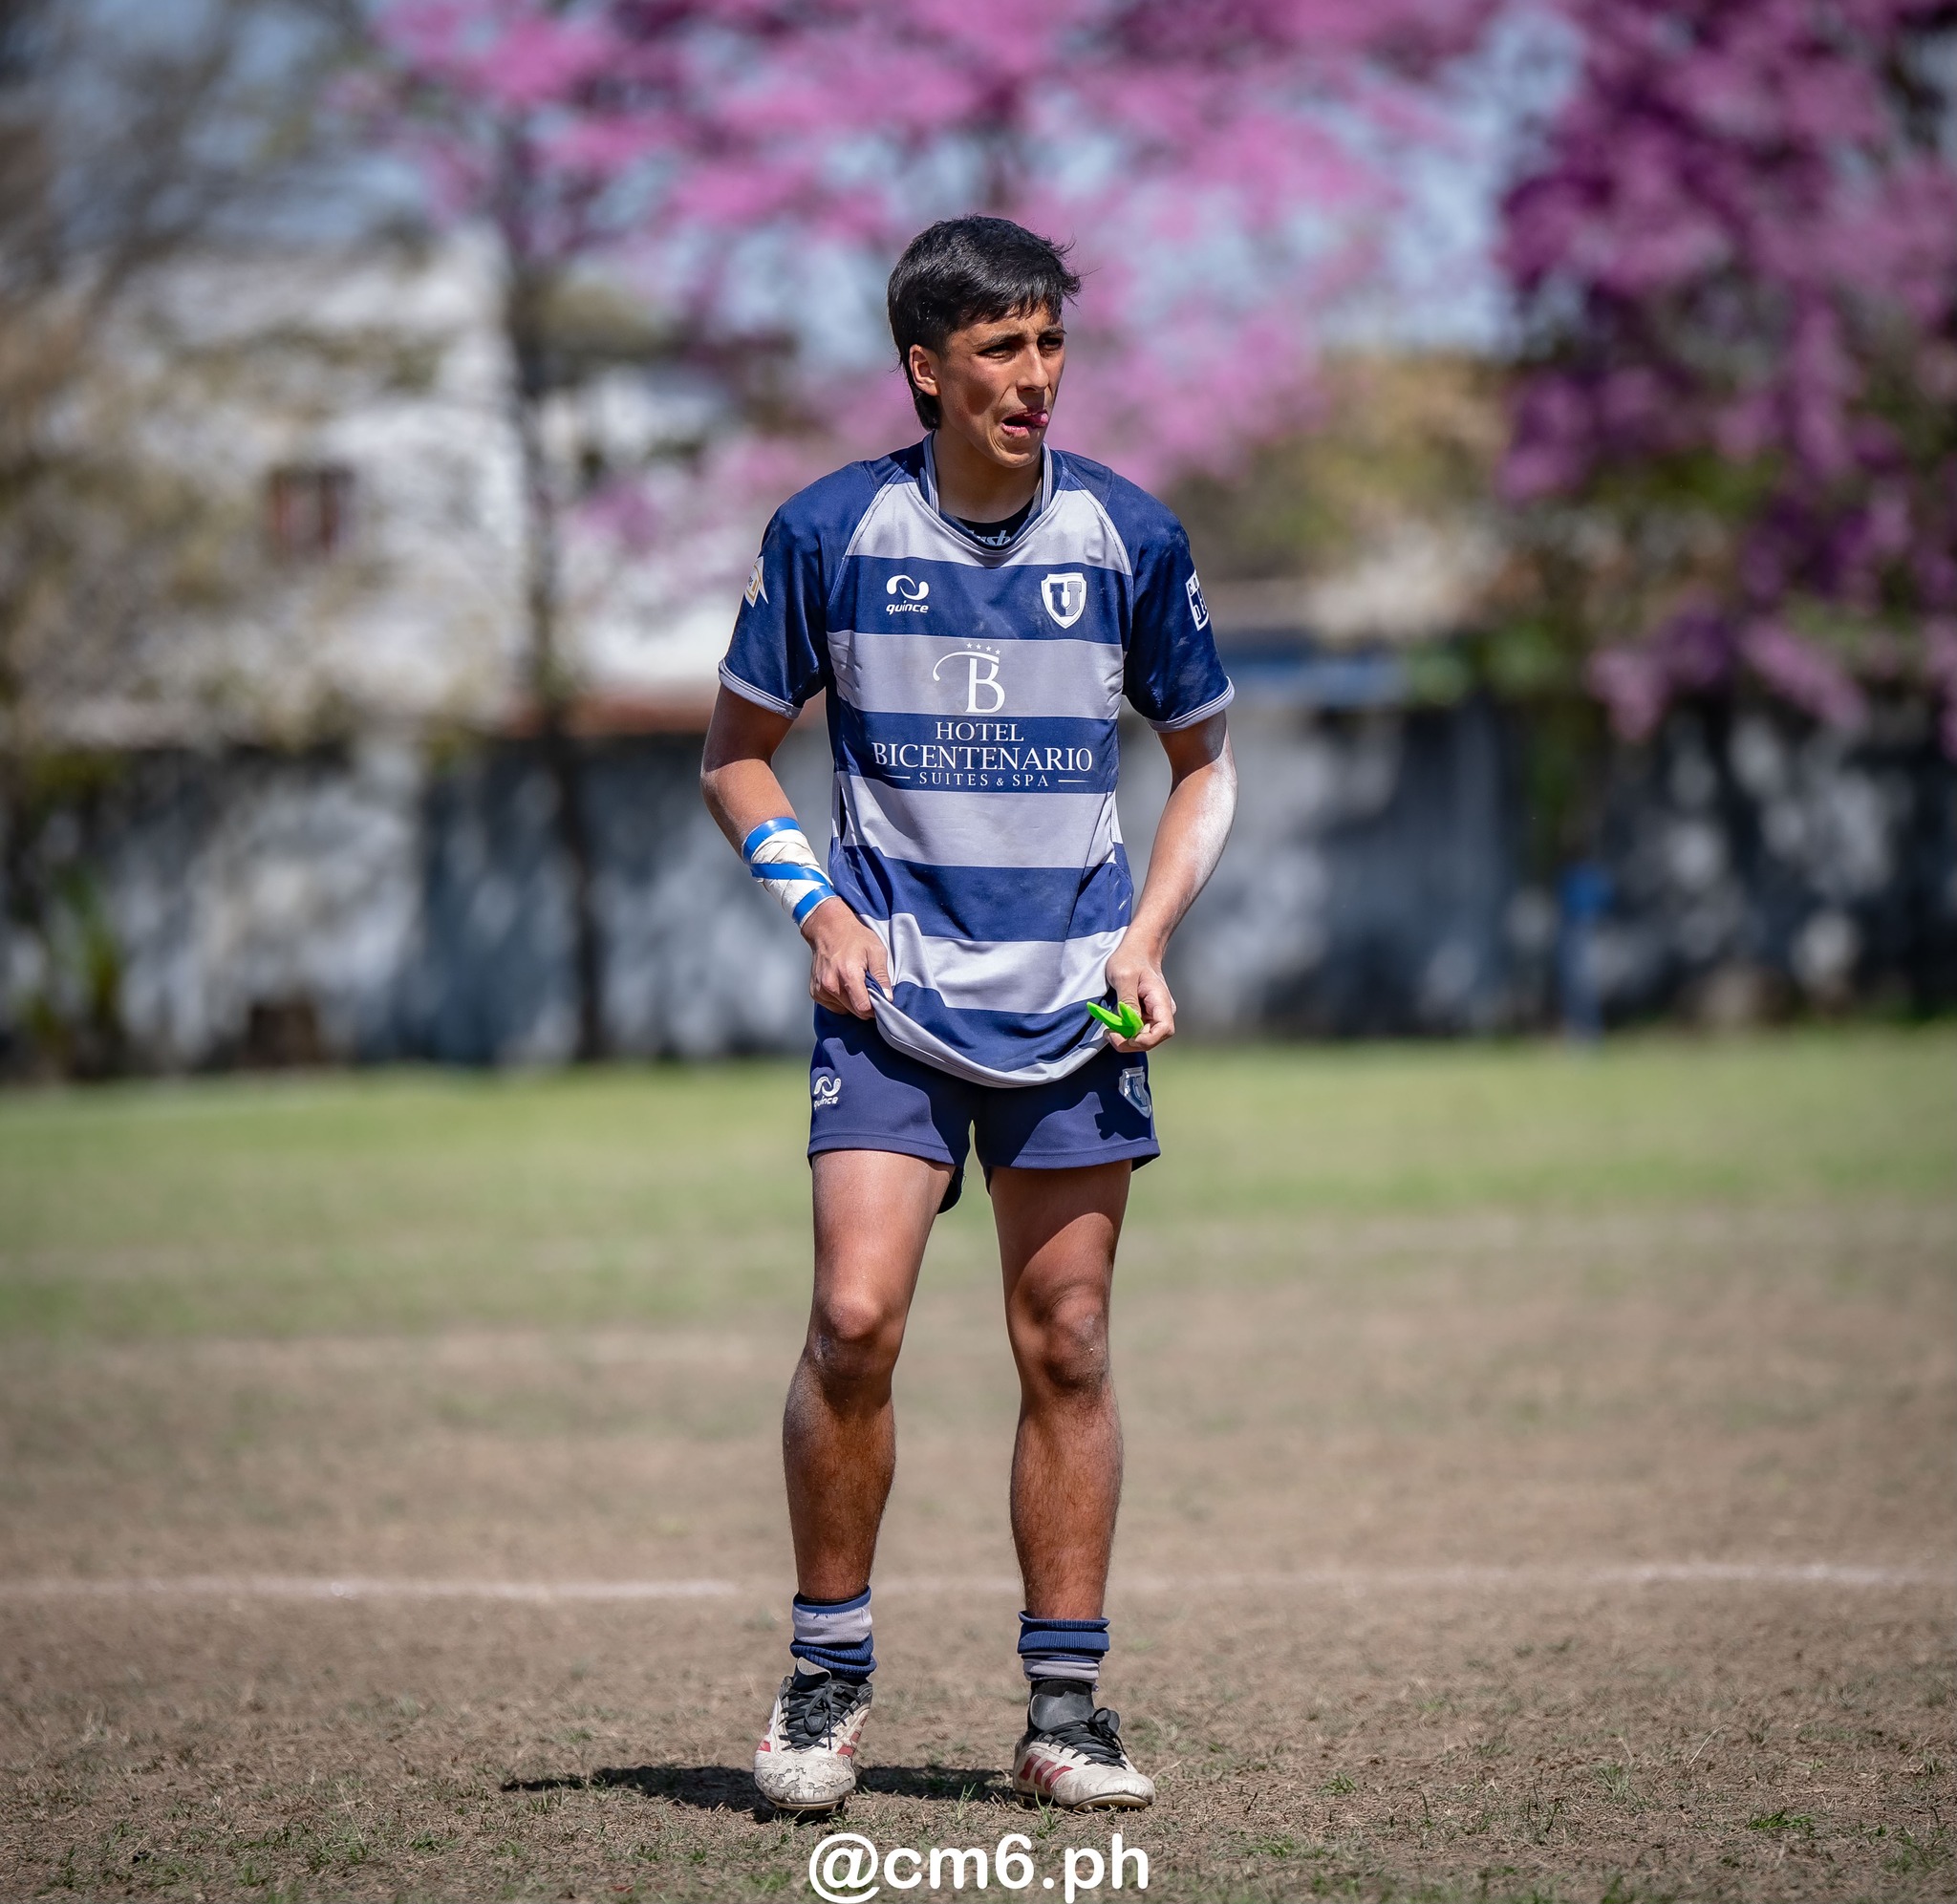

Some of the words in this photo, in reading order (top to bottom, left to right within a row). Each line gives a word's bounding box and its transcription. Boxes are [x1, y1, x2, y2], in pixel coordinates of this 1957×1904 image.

[886, 600, 929, 615] quince
[935, 721, 1024, 741] HOTEL
[871, 741, 1093, 772] BICENTENARIO
[919, 771, 988, 787] SUITES
[996, 777, 1004, 786] &
[1012, 773, 1049, 787] SPA
